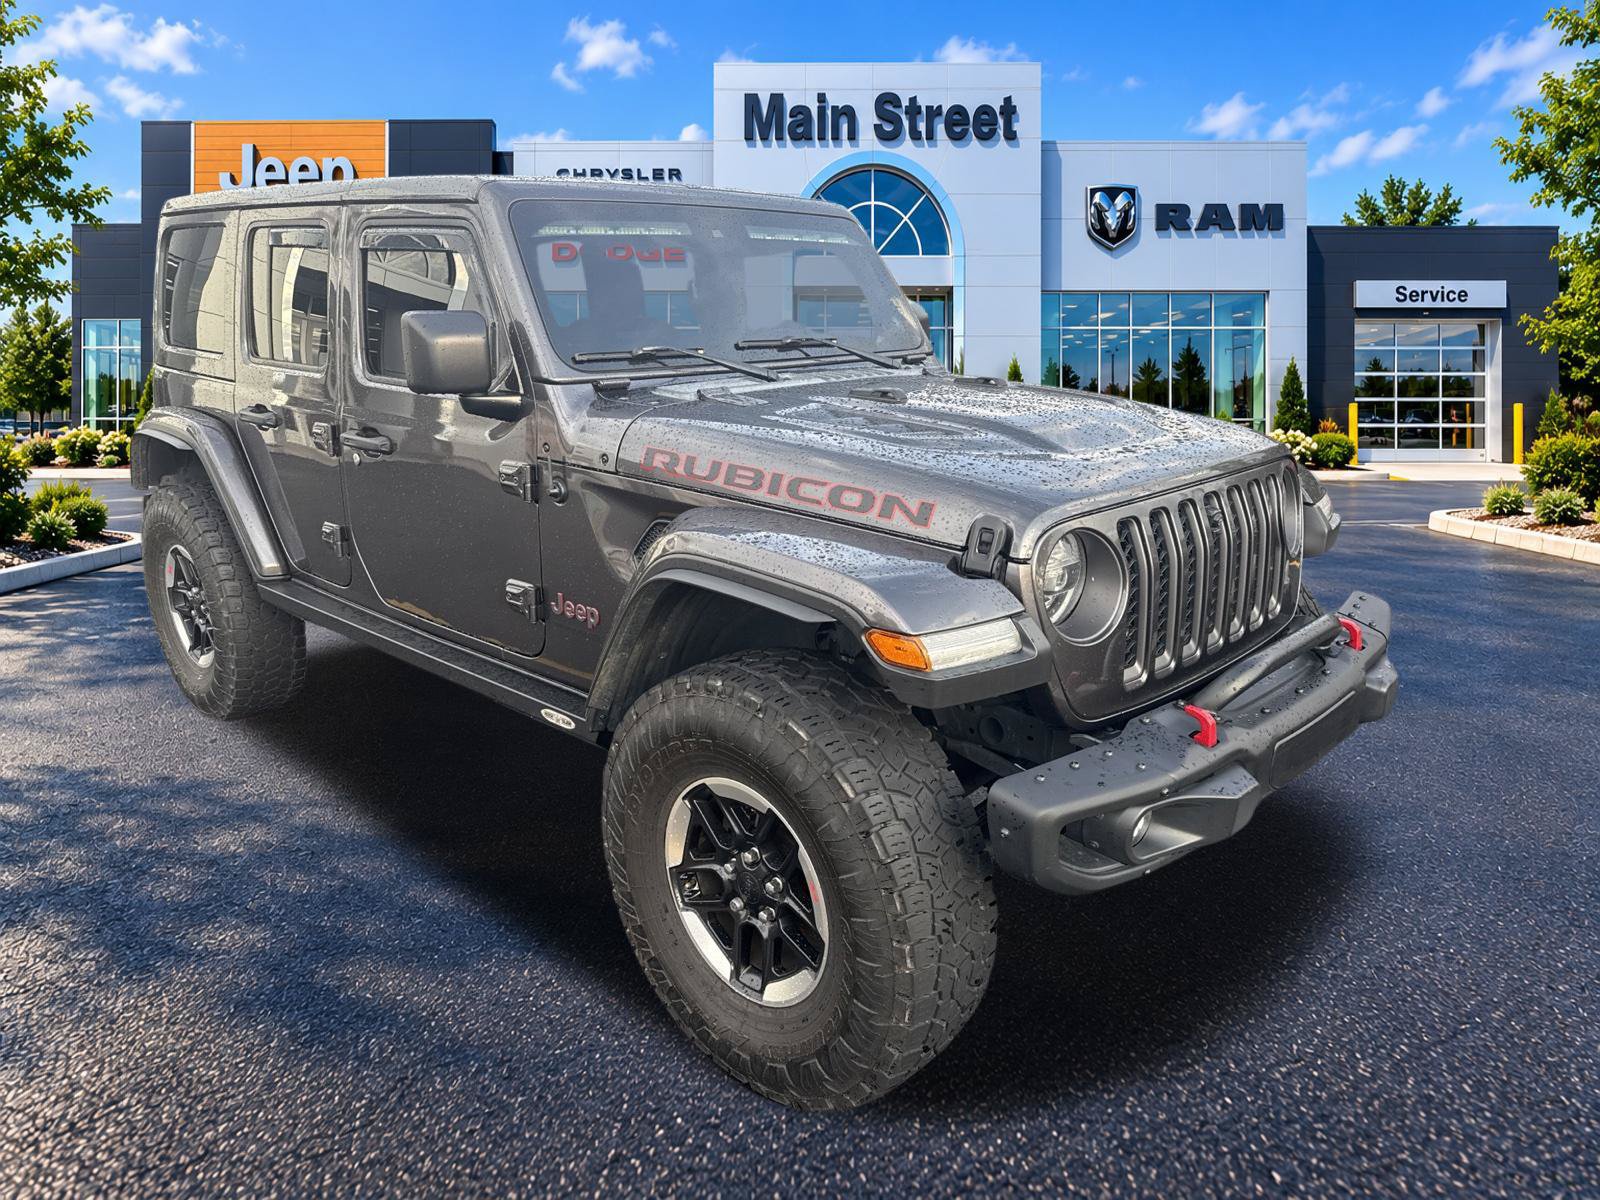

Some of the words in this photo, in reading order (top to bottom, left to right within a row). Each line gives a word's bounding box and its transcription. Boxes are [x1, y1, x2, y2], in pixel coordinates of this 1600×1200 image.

[743, 92, 856, 141] Main
[873, 91, 1018, 141] Street
[556, 167, 683, 181] CHRYSLER
[1155, 203, 1284, 231] RAM
[1395, 285, 1469, 303] Service
[639, 446, 936, 529] RUBICON
[550, 592, 601, 630] Jeep
